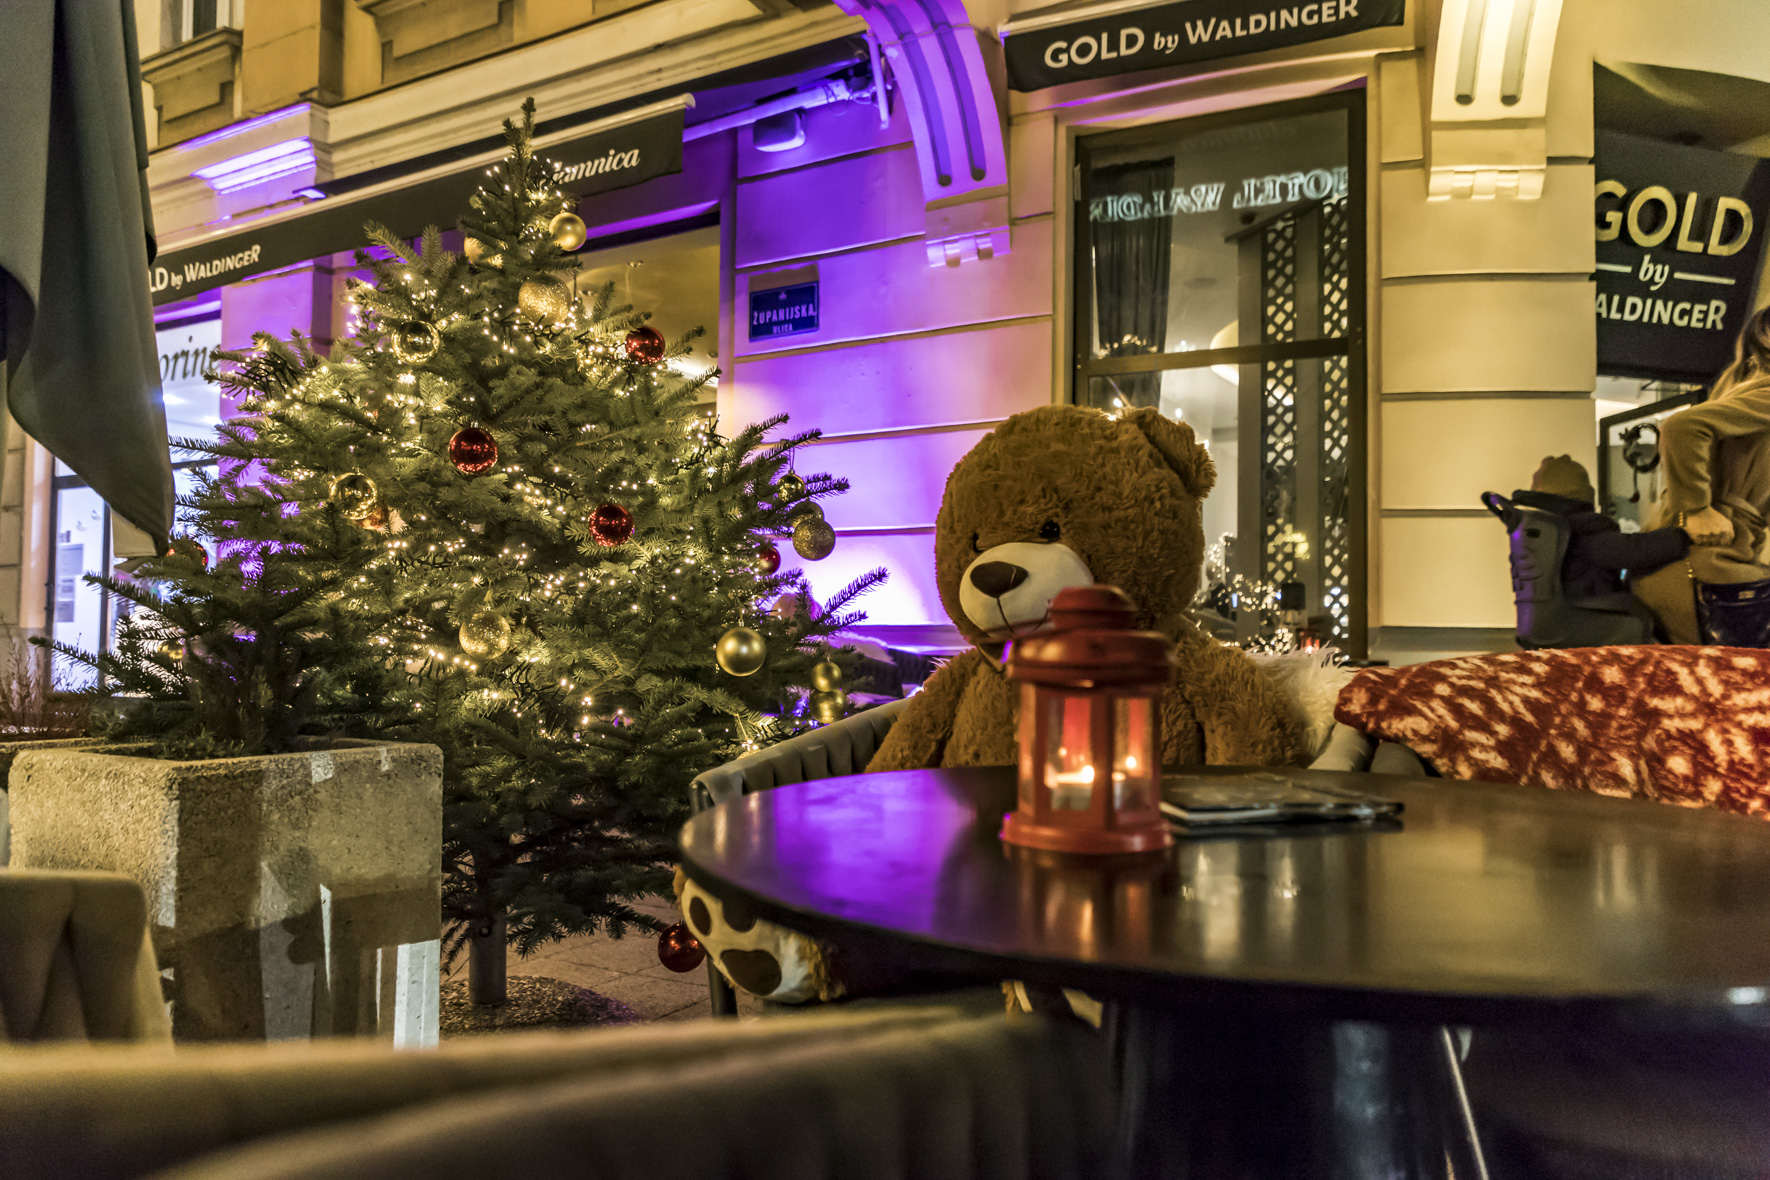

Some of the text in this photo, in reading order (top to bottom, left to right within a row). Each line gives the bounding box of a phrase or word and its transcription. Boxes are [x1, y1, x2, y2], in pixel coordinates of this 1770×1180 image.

[1044, 0, 1359, 68] GOLD by WALDINGER
[1595, 179, 1753, 257] GOLD
[148, 244, 261, 292] LD by WALDINGER
[1638, 254, 1669, 291] by
[1596, 293, 1727, 330] ALDINGER
